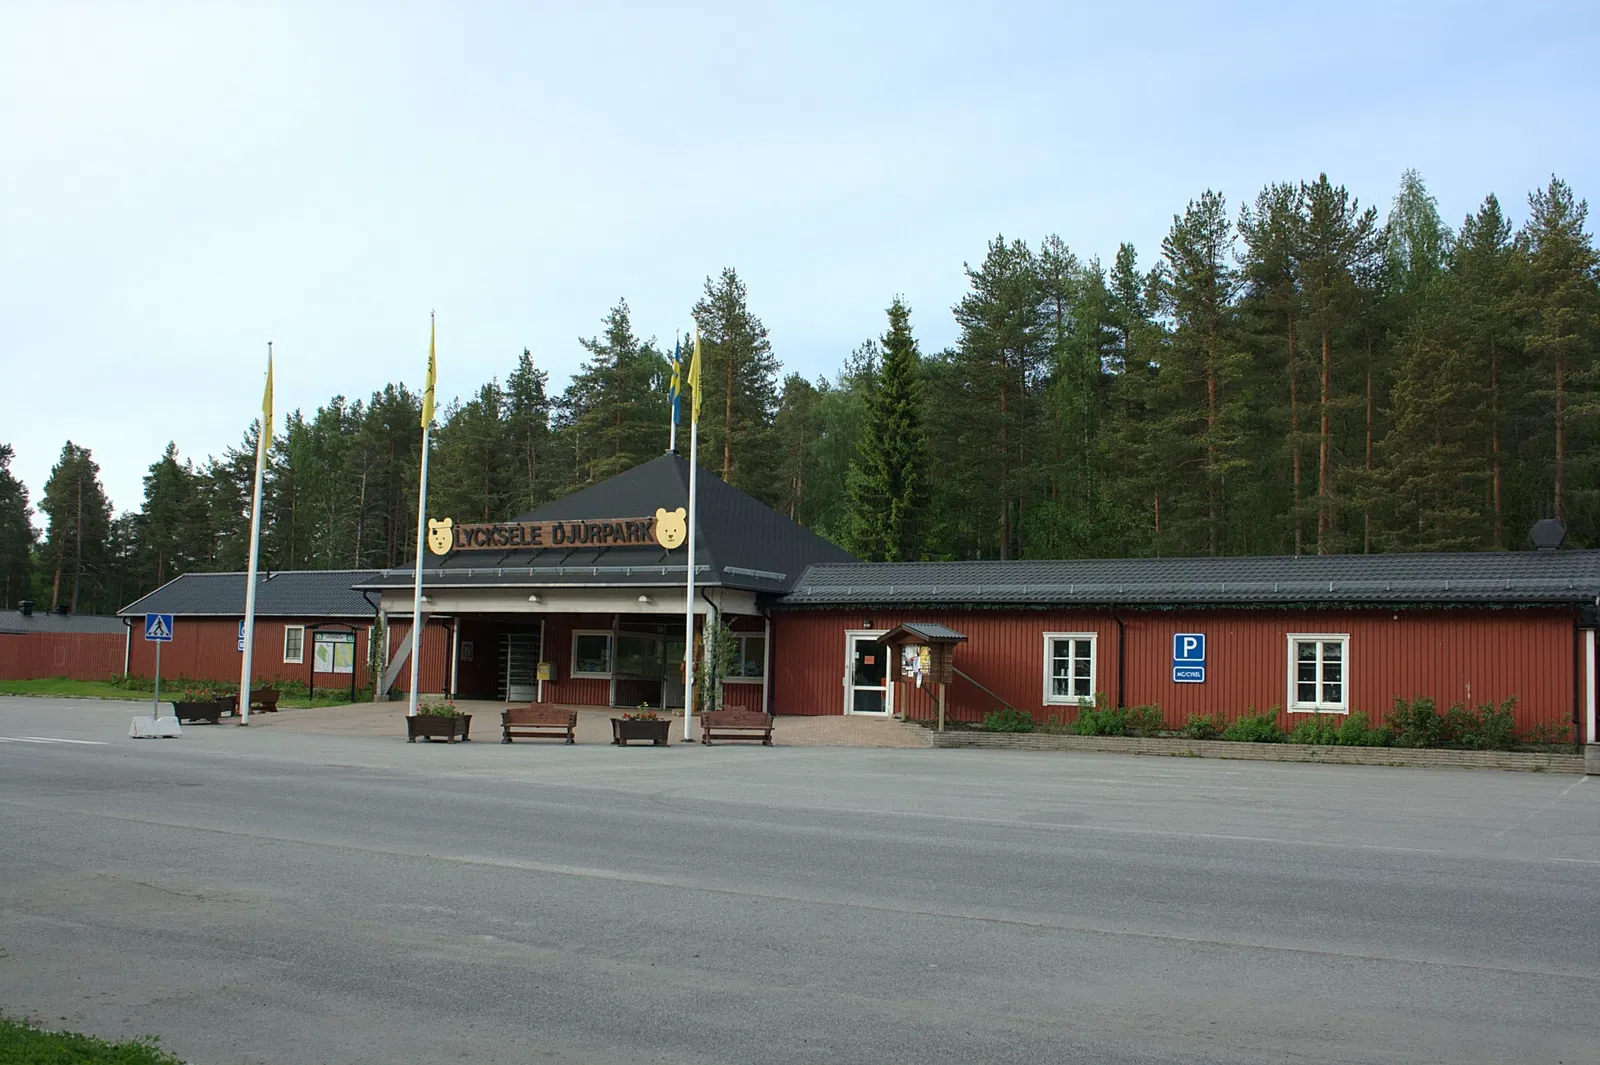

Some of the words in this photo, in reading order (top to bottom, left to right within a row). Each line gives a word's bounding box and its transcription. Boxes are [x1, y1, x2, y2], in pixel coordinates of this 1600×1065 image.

[454, 526, 542, 547] LYCKSELE
[552, 521, 653, 545] DJURPARK
[1183, 637, 1197, 657] P
